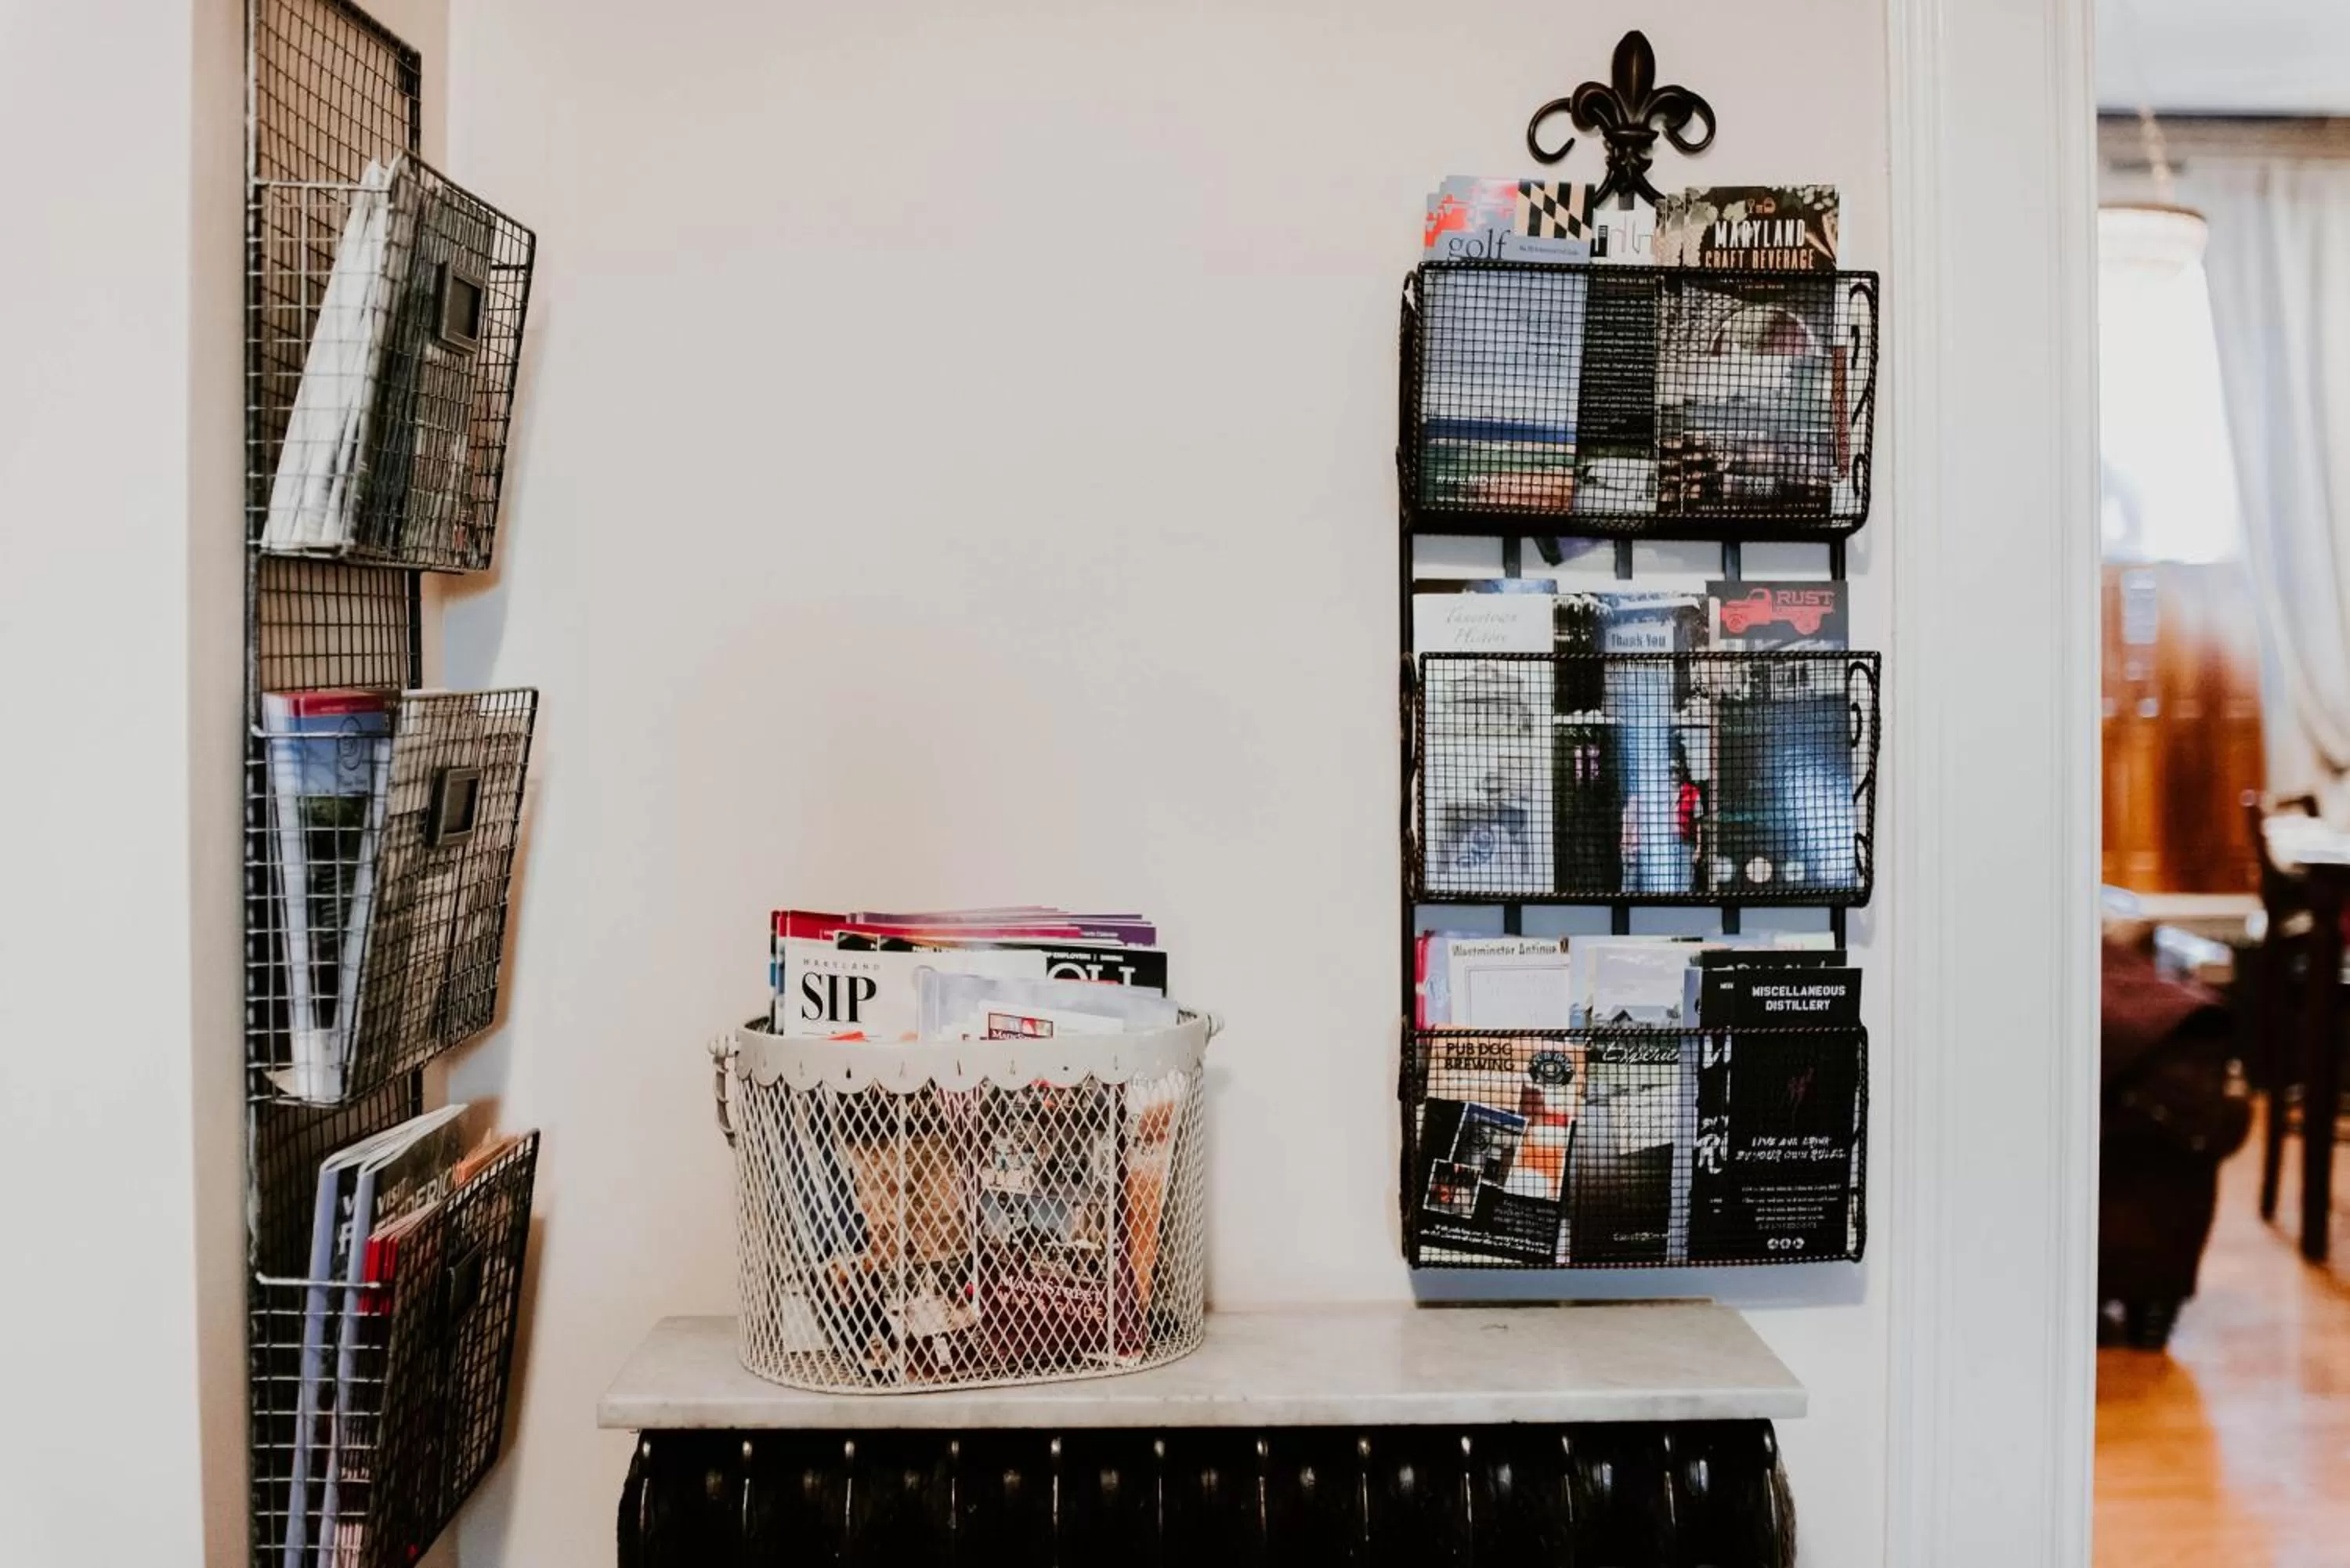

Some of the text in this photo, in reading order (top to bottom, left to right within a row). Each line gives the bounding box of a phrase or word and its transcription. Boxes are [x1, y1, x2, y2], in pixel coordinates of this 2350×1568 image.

[1715, 219, 1806, 248] MARYLAND
[1448, 228, 1511, 259] golf
[1705, 247, 1815, 269] CRAFT BEVERAGE
[1776, 589, 1835, 605] RUST
[801, 972, 877, 1022] SIP
[1752, 985, 1846, 997] MISCELLANEOUS
[1766, 999, 1831, 1011] DISTILLERY
[1446, 1042, 1513, 1055] PUB DOG
[1444, 1057, 1515, 1071] BREWING
[377, 1177, 408, 1216] VISIT
